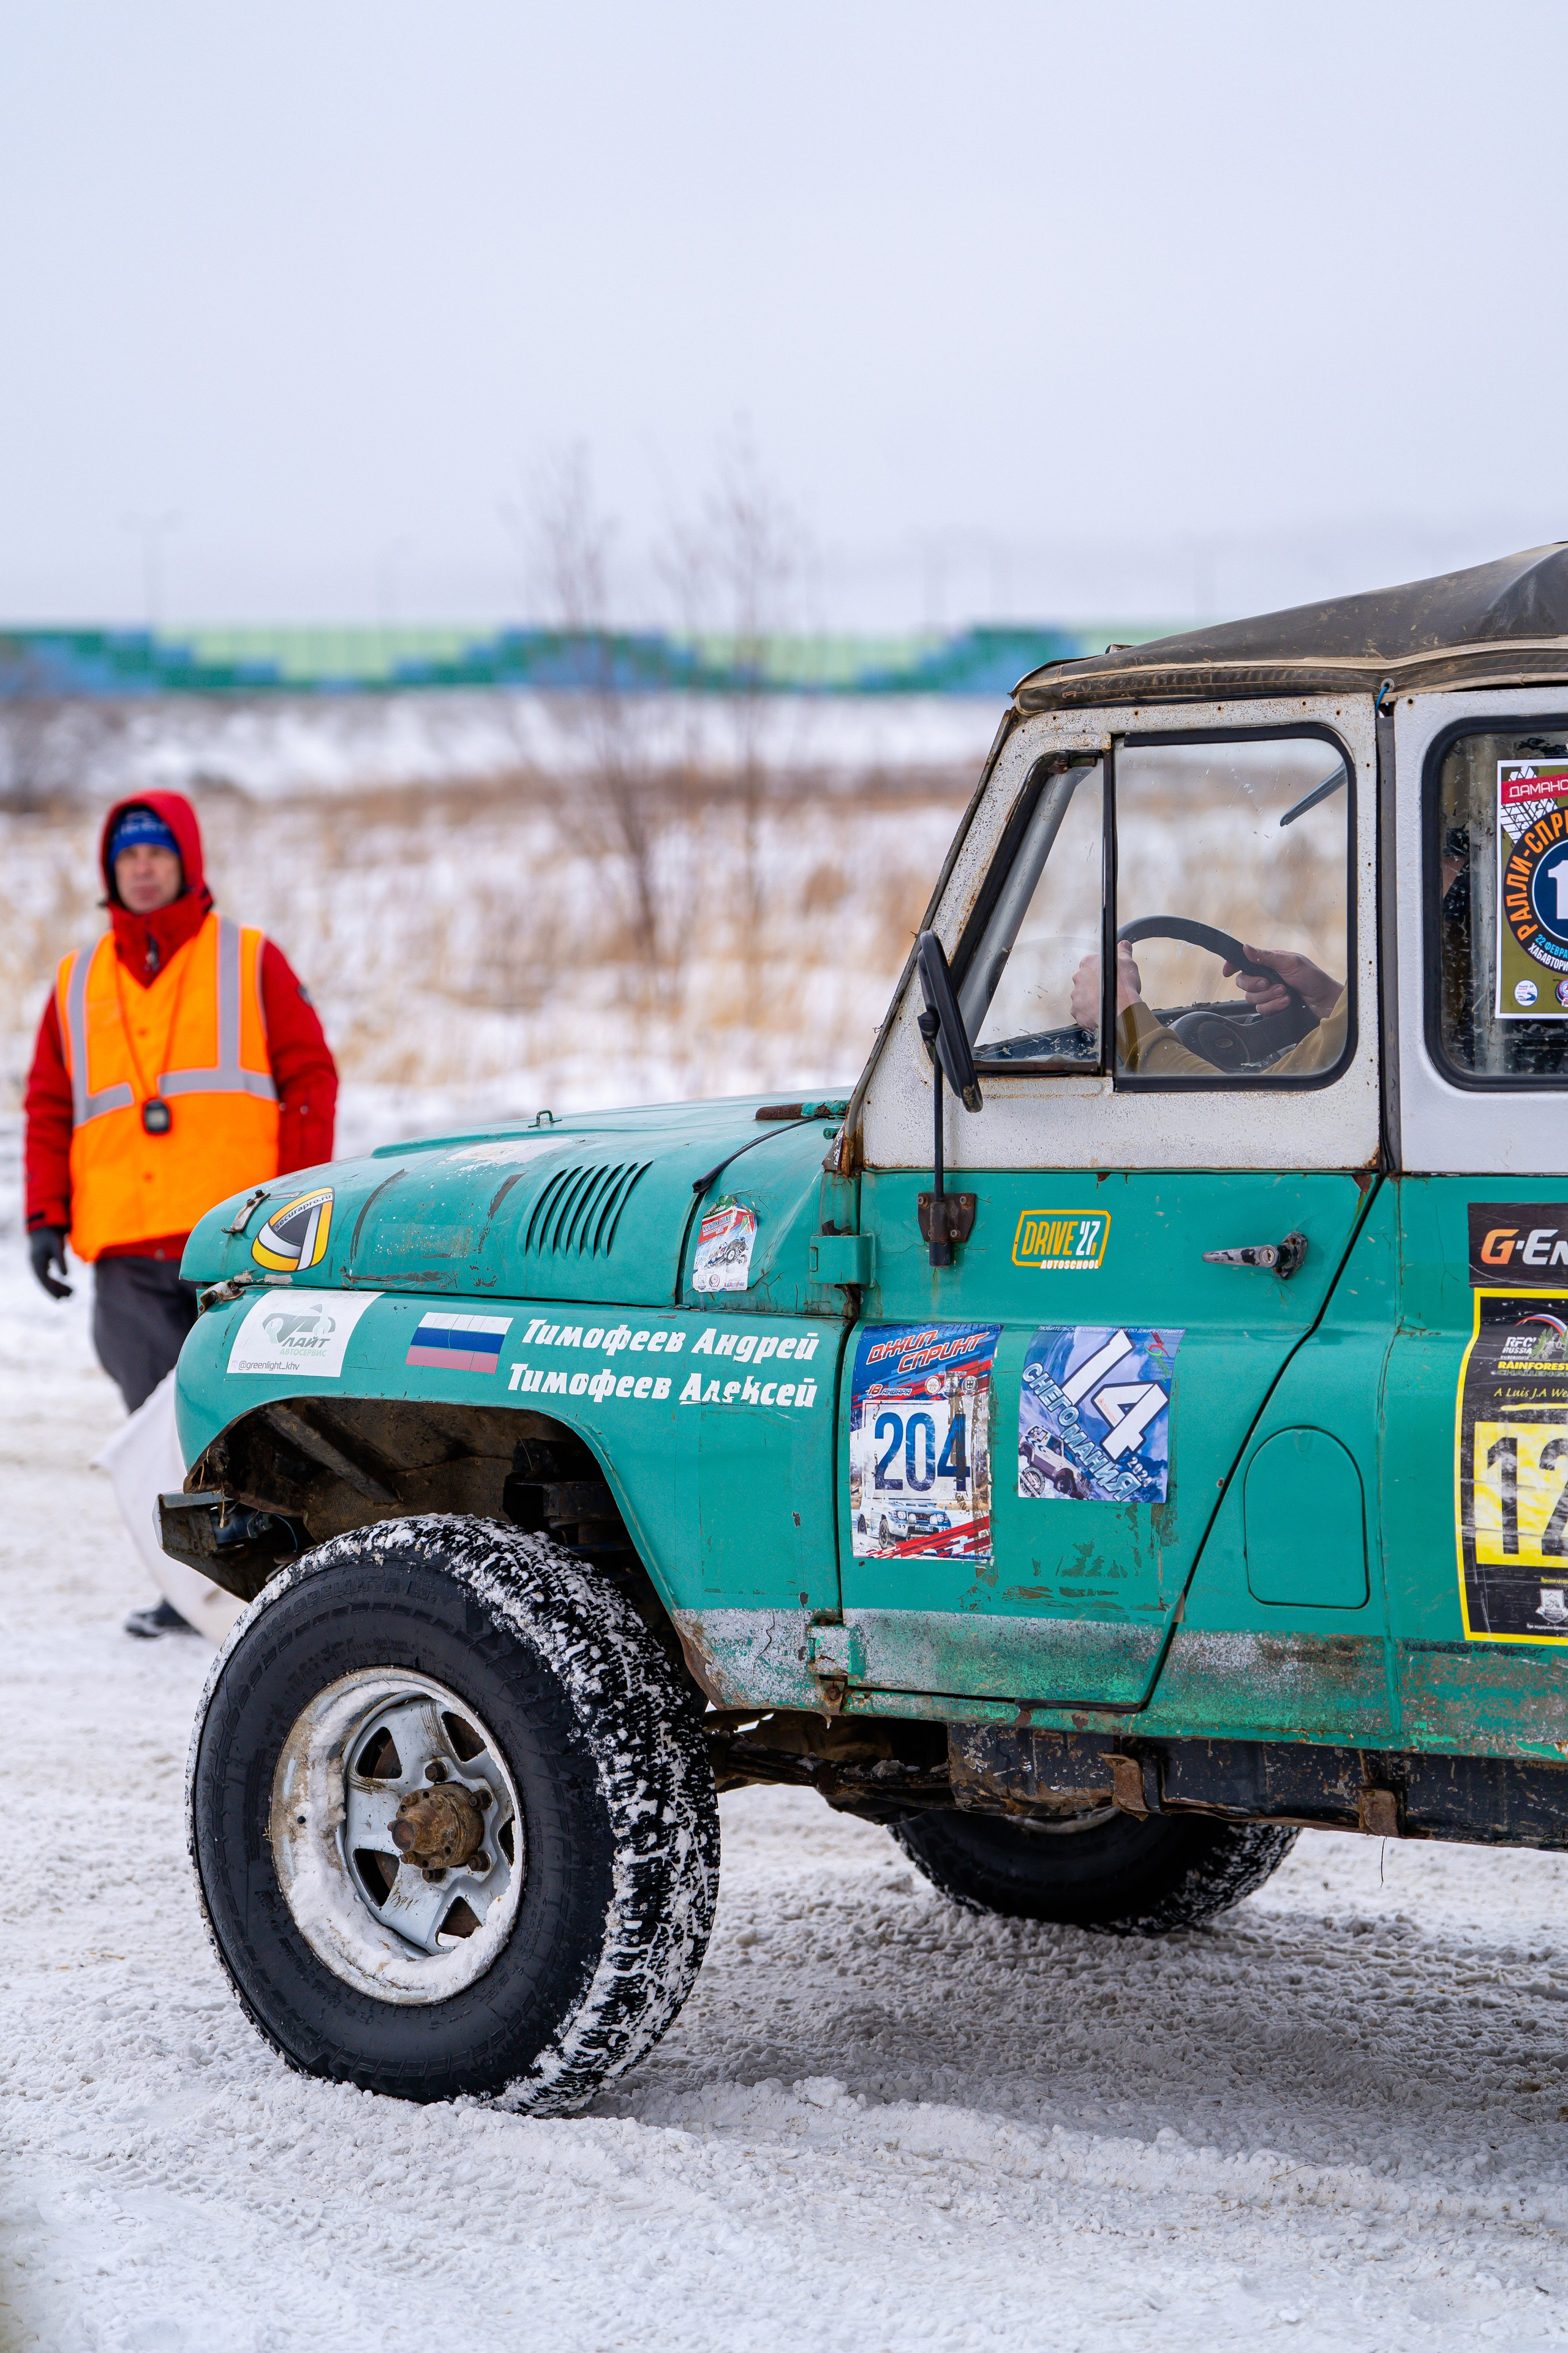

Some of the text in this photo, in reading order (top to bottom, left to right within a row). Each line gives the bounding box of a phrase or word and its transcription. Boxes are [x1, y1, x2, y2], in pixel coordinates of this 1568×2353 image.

[1535, 934, 1546, 946] 22
[276, 1195, 331, 1230] securapro.ru
[703, 1219, 718, 1232] КУБОК
[1040, 1260, 1099, 1269] AUTOSCHOOL
[281, 1337, 331, 1348] ЛАЙТ
[522, 1318, 820, 1364] Тимофеев Андрей
[866, 1330, 938, 1365] ДЖИП
[279, 1348, 327, 1357] АВТОСЕРВИС
[897, 1332, 990, 1373] СПРИНТ
[238, 1360, 300, 1370] @greenlight_khv
[508, 1363, 818, 1408] Тимофеев Алексей
[867, 1384, 883, 1396] 18
[1493, 1388, 1502, 1397] A
[1506, 1386, 1529, 1397] Luis
[1022, 1362, 1142, 1501] СНЕГОМАНИЯ
[875, 1412, 971, 1492] 204
[1127, 1456, 1153, 1488] 2024
